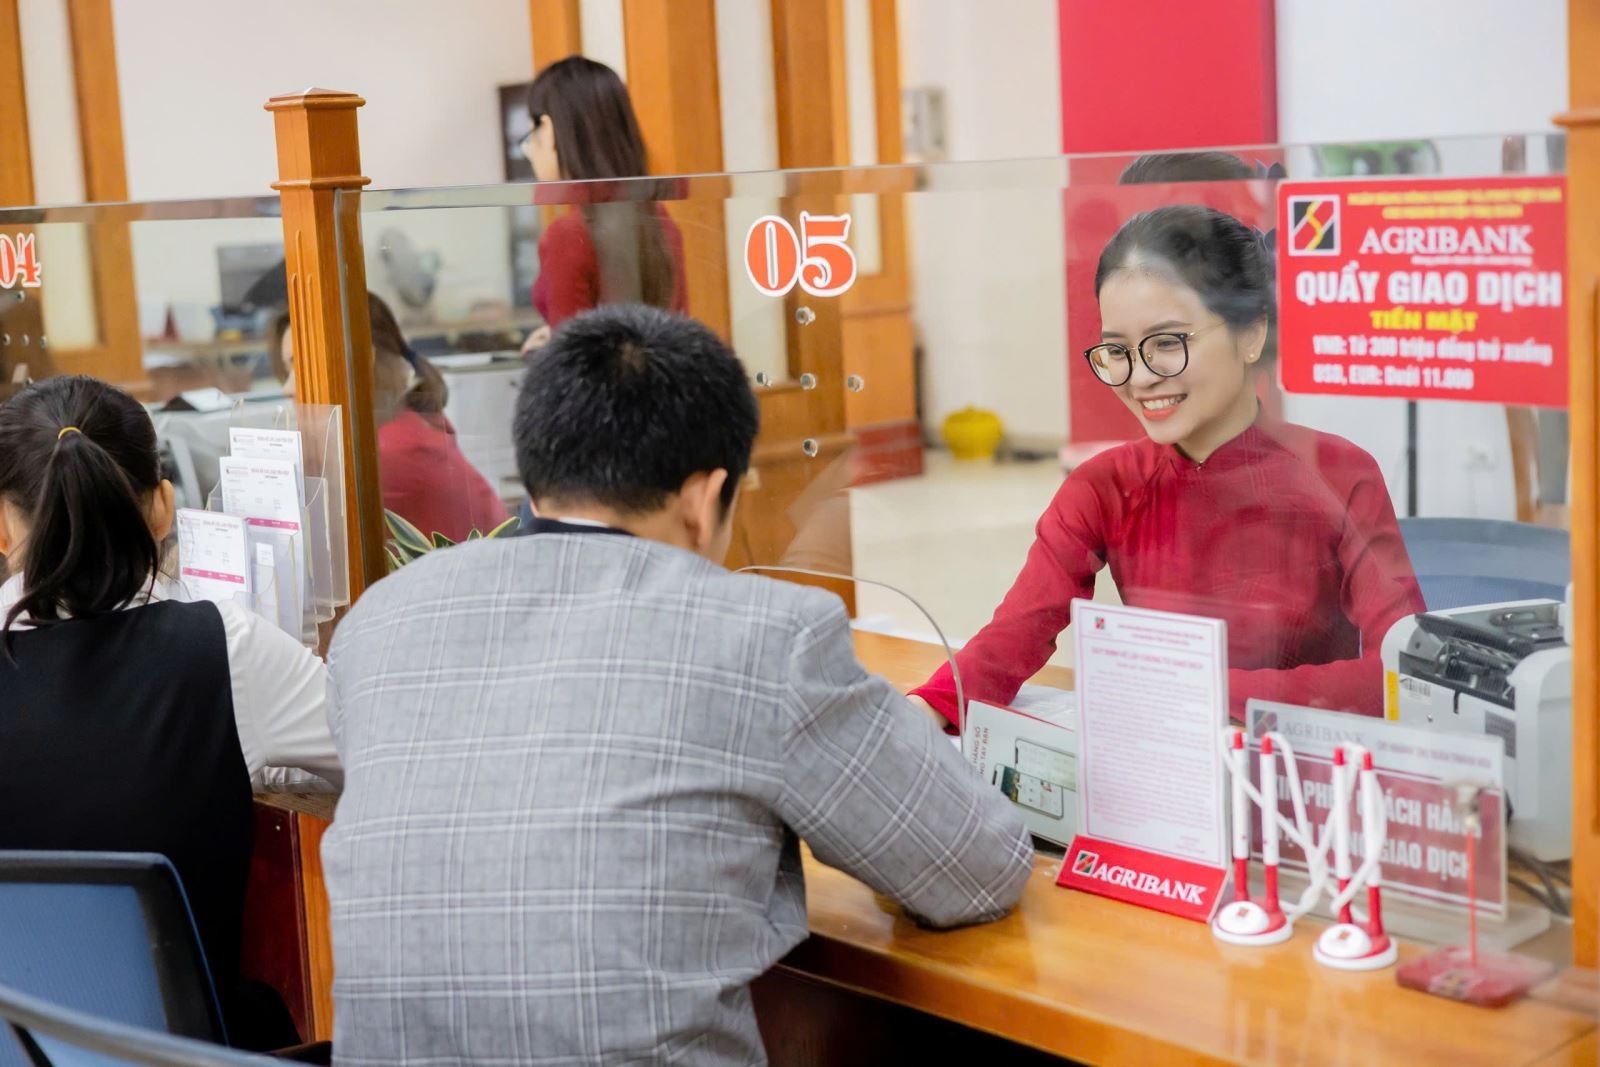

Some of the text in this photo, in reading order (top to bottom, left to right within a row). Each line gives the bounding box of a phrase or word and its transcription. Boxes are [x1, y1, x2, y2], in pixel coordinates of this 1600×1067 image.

[0, 232, 42, 289] 04
[744, 210, 857, 298] 05
[1359, 225, 1534, 254] AGRIBANK
[1387, 271, 1468, 306] GIAO
[1476, 271, 1562, 312] DỊCH
[1093, 863, 1208, 905] AGRIBANK
